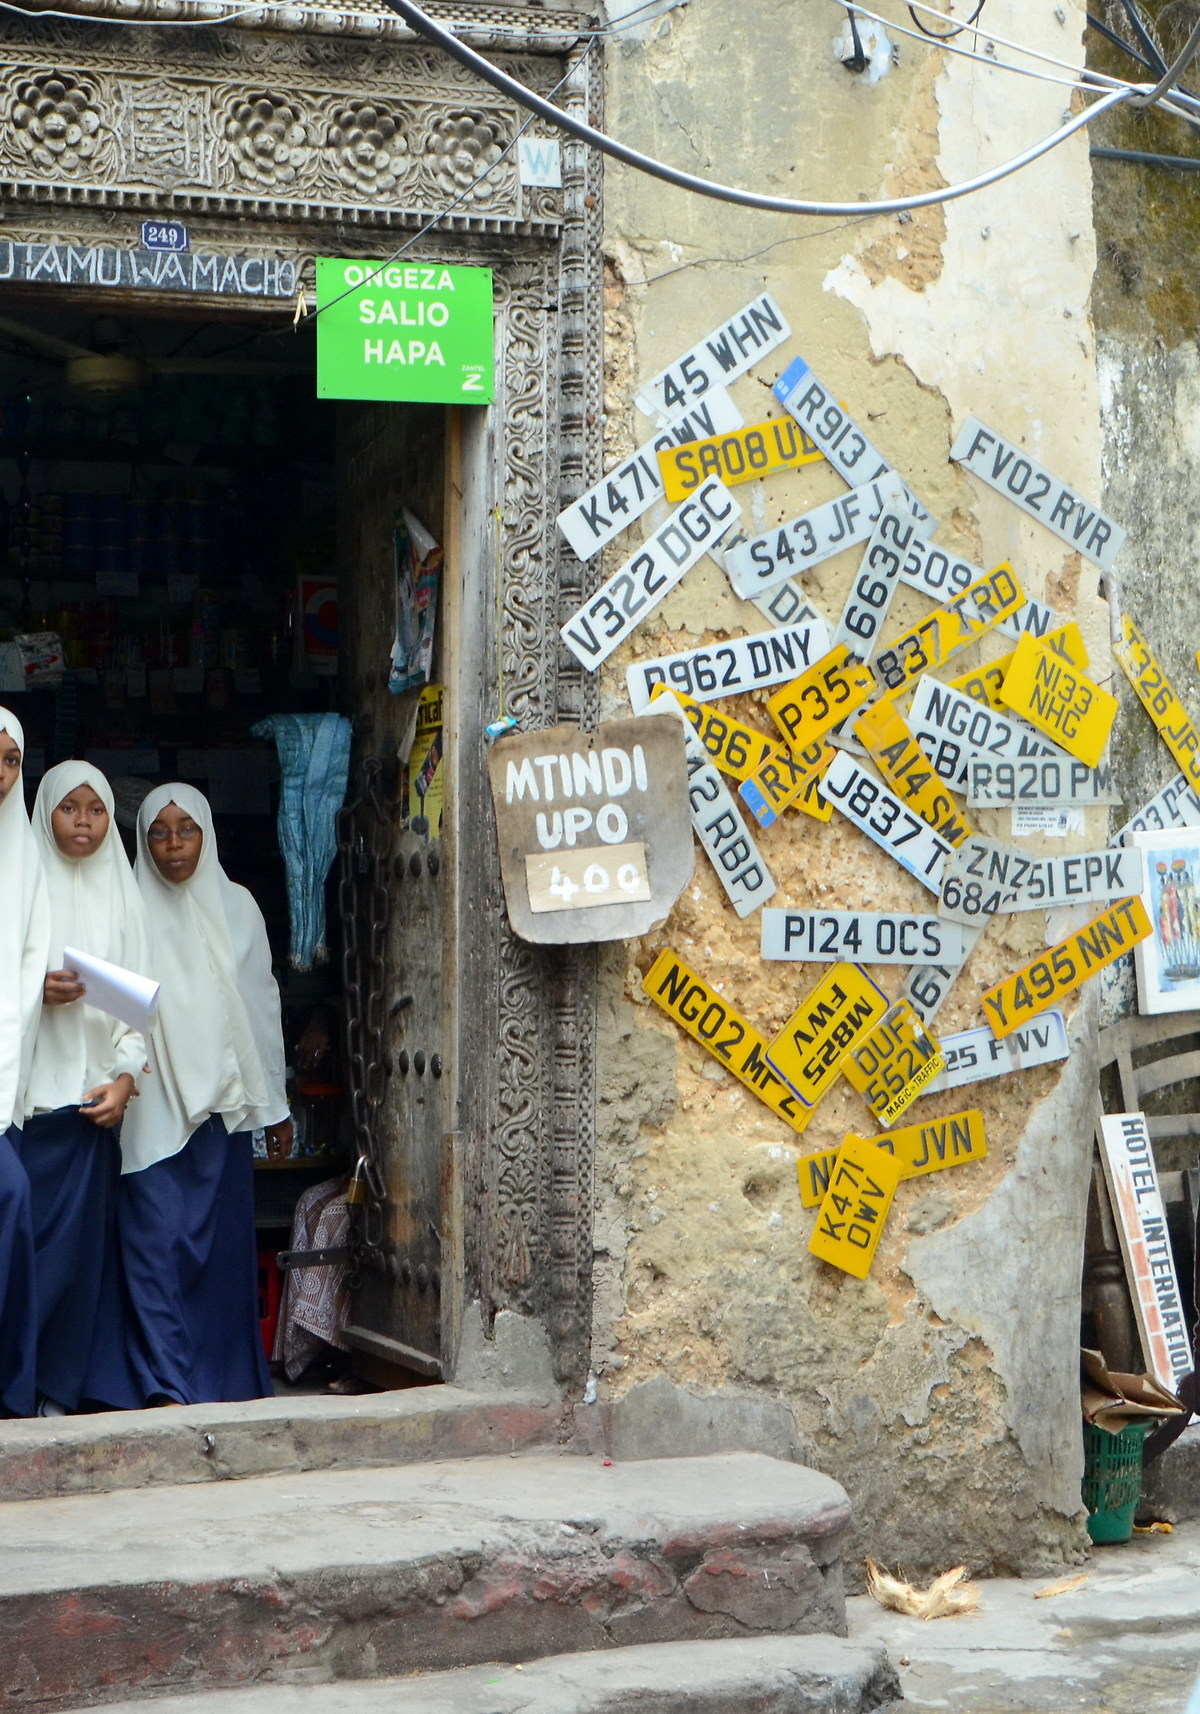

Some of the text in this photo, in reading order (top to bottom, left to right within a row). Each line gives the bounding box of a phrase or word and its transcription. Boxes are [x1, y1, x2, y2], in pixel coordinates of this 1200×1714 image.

[524, 144, 554, 175] W
[148, 227, 178, 244] 249
[192, 253, 298, 297] MACHO
[343, 265, 455, 291] ONGEZA
[358, 300, 450, 327] SALIO
[364, 339, 446, 367] HAPA
[796, 382, 866, 468] R913
[1050, 490, 1113, 558] RVR
[567, 552, 668, 656] V322
[656, 483, 732, 567] DGC
[747, 628, 811, 679] DNY
[505, 744, 648, 804] MTINDI
[972, 762, 1065, 800] R920
[536, 803, 629, 849] UPO
[826, 769, 923, 847] J837
[704, 808, 766, 892] RBP
[1063, 853, 1126, 895] EPK
[550, 863, 641, 902] 400
[985, 943, 1076, 1027] Y495
[1075, 898, 1139, 969] NNT
[792, 982, 848, 1057] FWV
[801, 995, 874, 1088] M825
[913, 1057, 941, 1088] TRAFFIC
[912, 1116, 973, 1168] JVN
[1120, 1117, 1157, 1205] HOTEL
